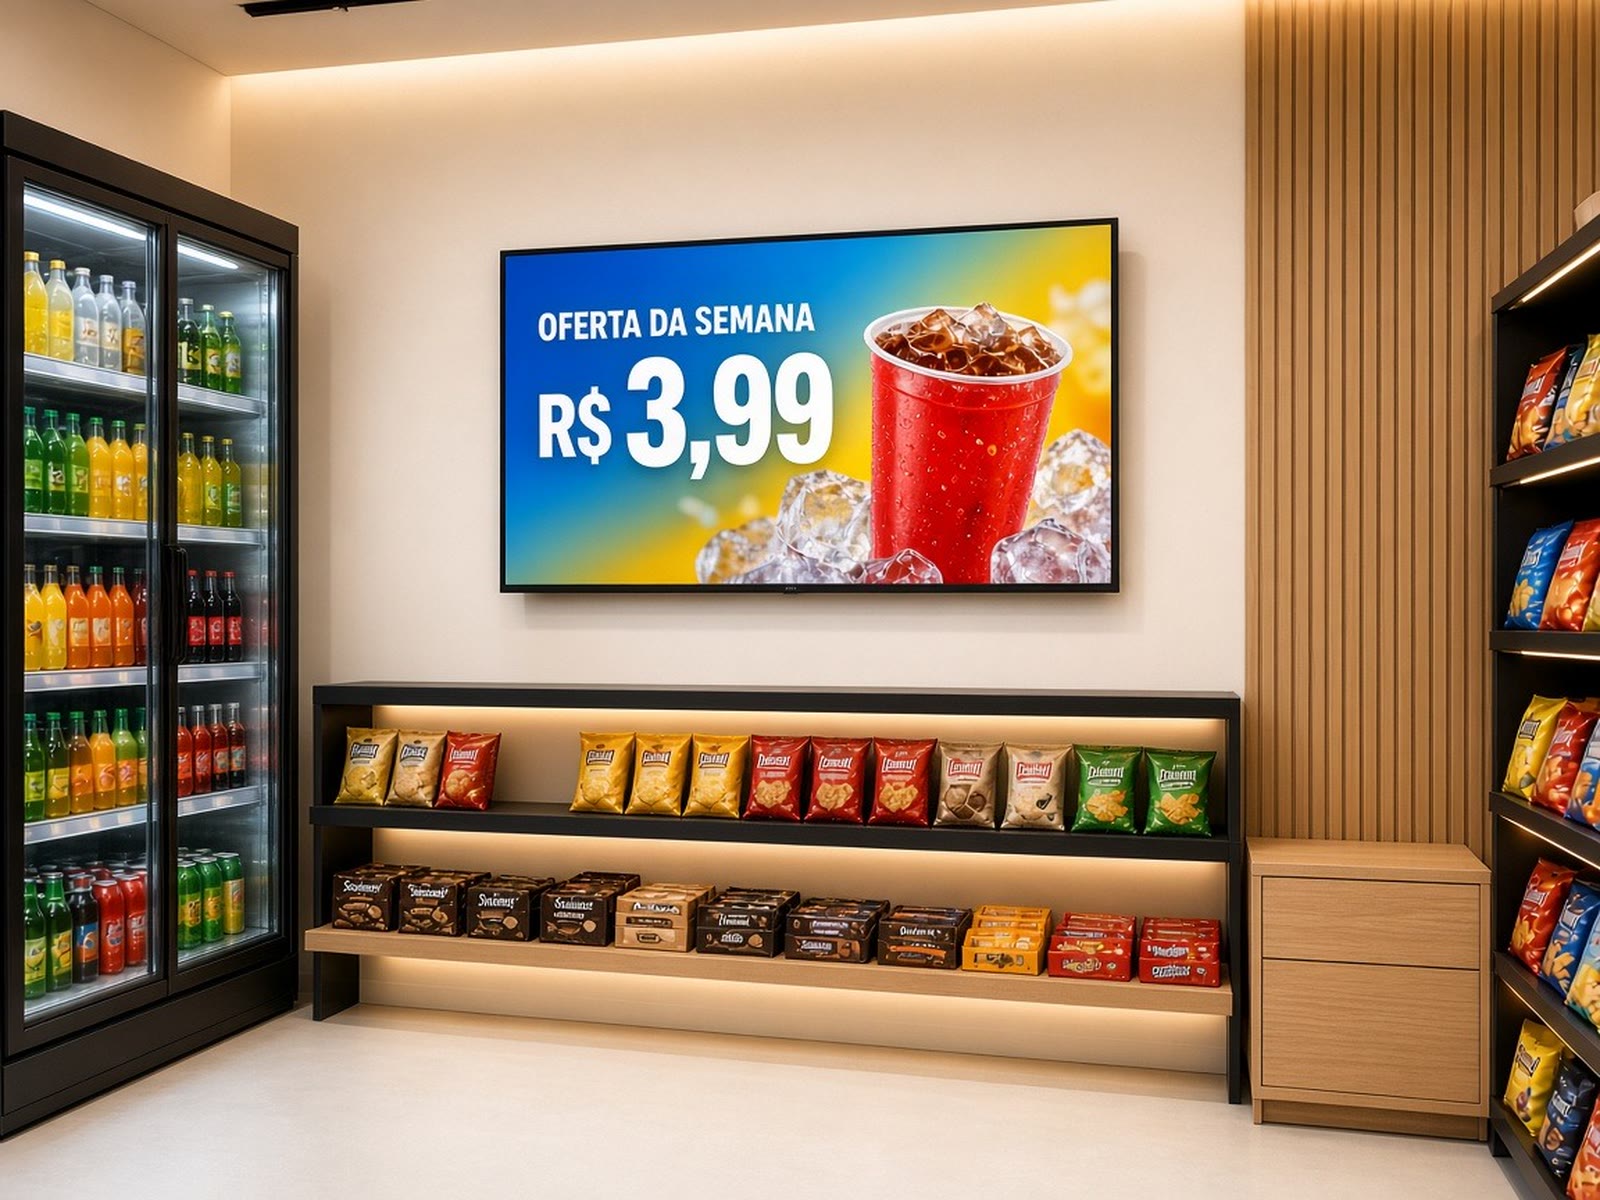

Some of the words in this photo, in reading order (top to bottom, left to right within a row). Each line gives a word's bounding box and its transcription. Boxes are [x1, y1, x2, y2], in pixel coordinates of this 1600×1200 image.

[538, 309, 642, 341] OFERTA
[650, 307, 688, 337] DA
[695, 302, 815, 335] SEMANA
[539, 386, 612, 465] R$
[626, 352, 834, 480] 3,99
